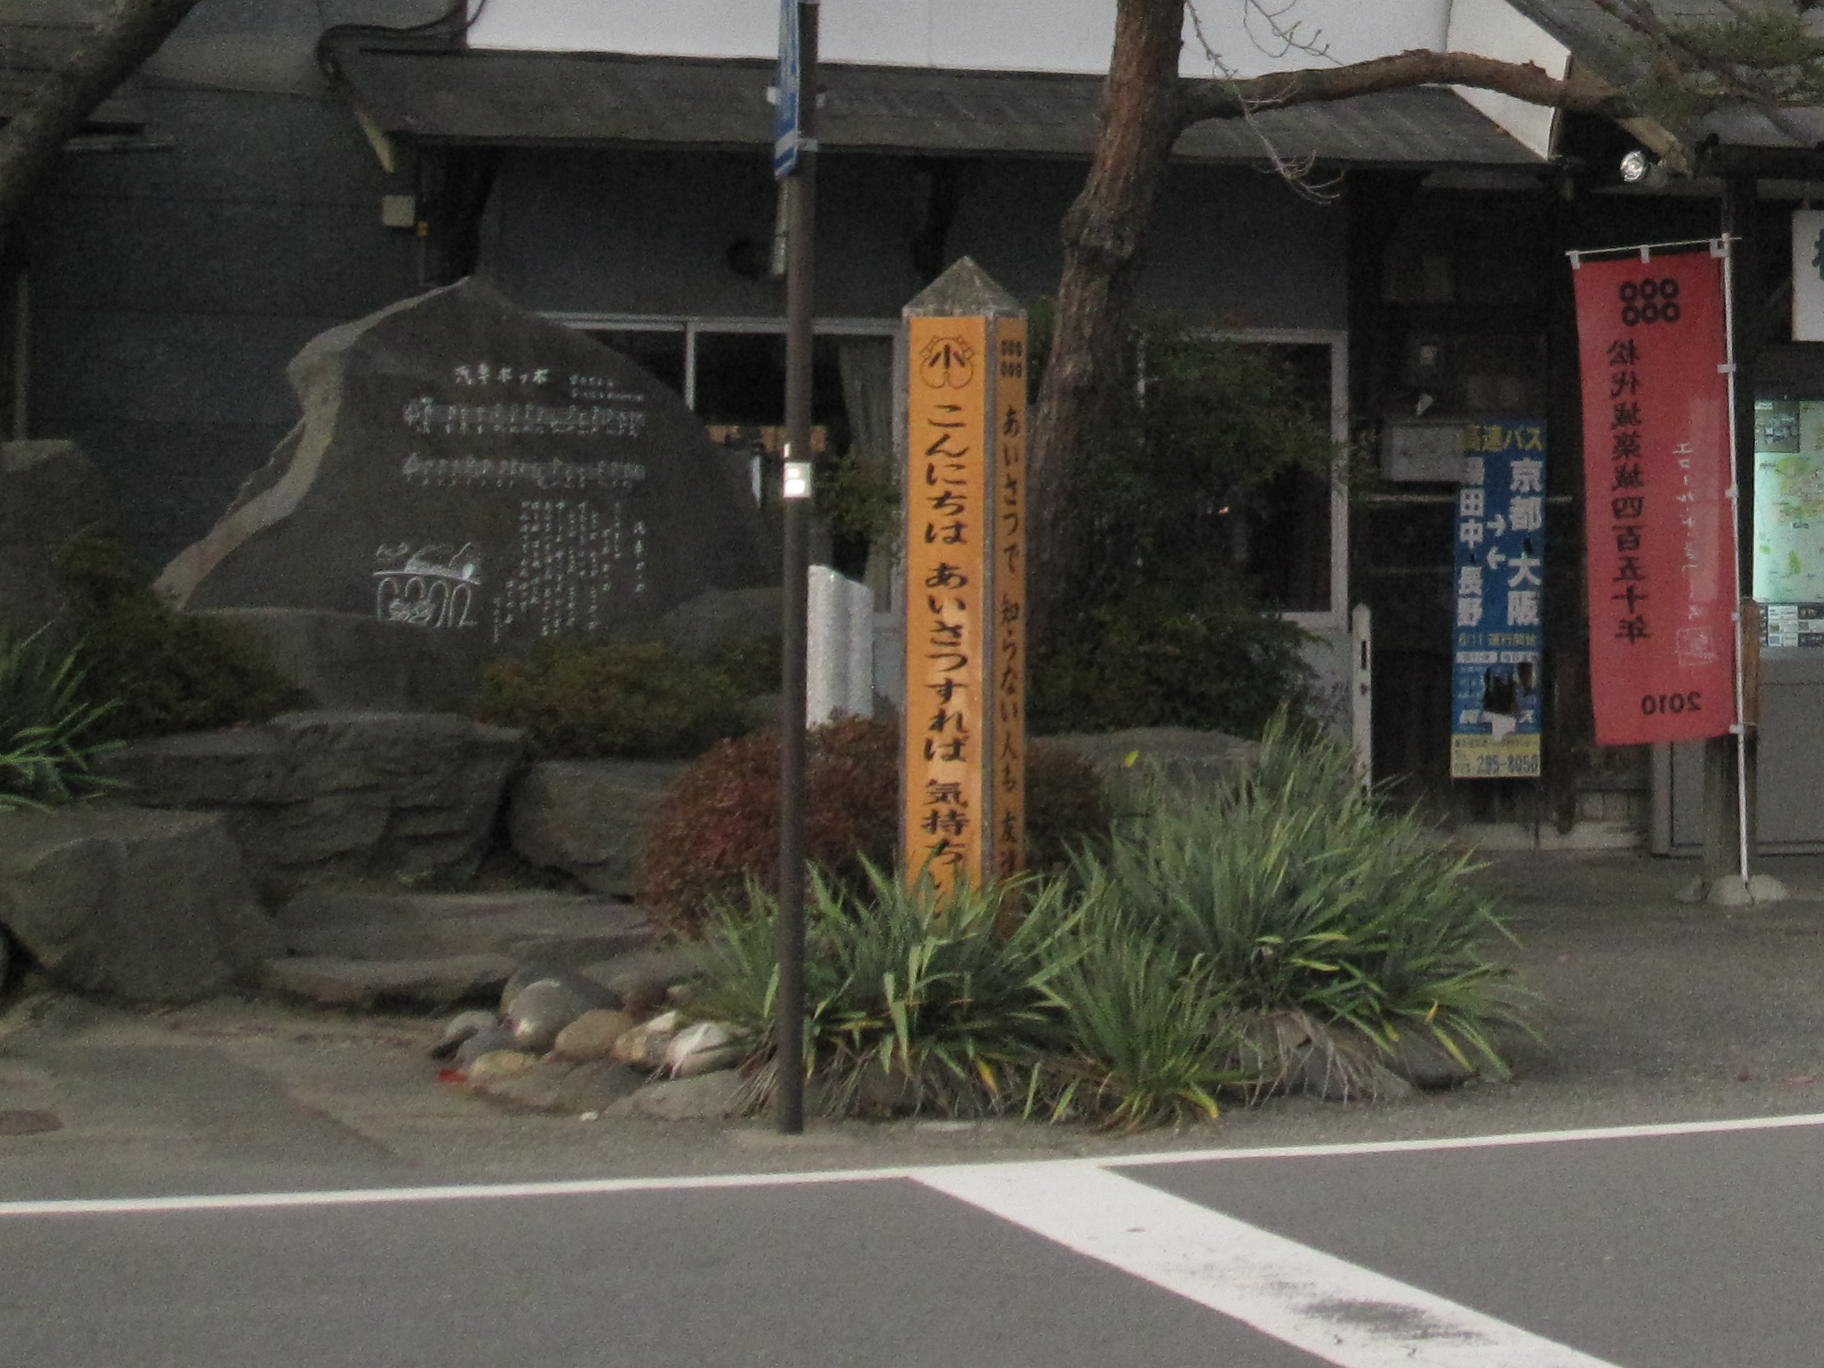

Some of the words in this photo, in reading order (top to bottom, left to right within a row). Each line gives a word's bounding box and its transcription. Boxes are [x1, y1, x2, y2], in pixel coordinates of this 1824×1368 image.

[924, 403, 970, 544] こんにちは
[1002, 406, 1021, 574] あいさつで
[924, 562, 969, 763] あいさつすれば
